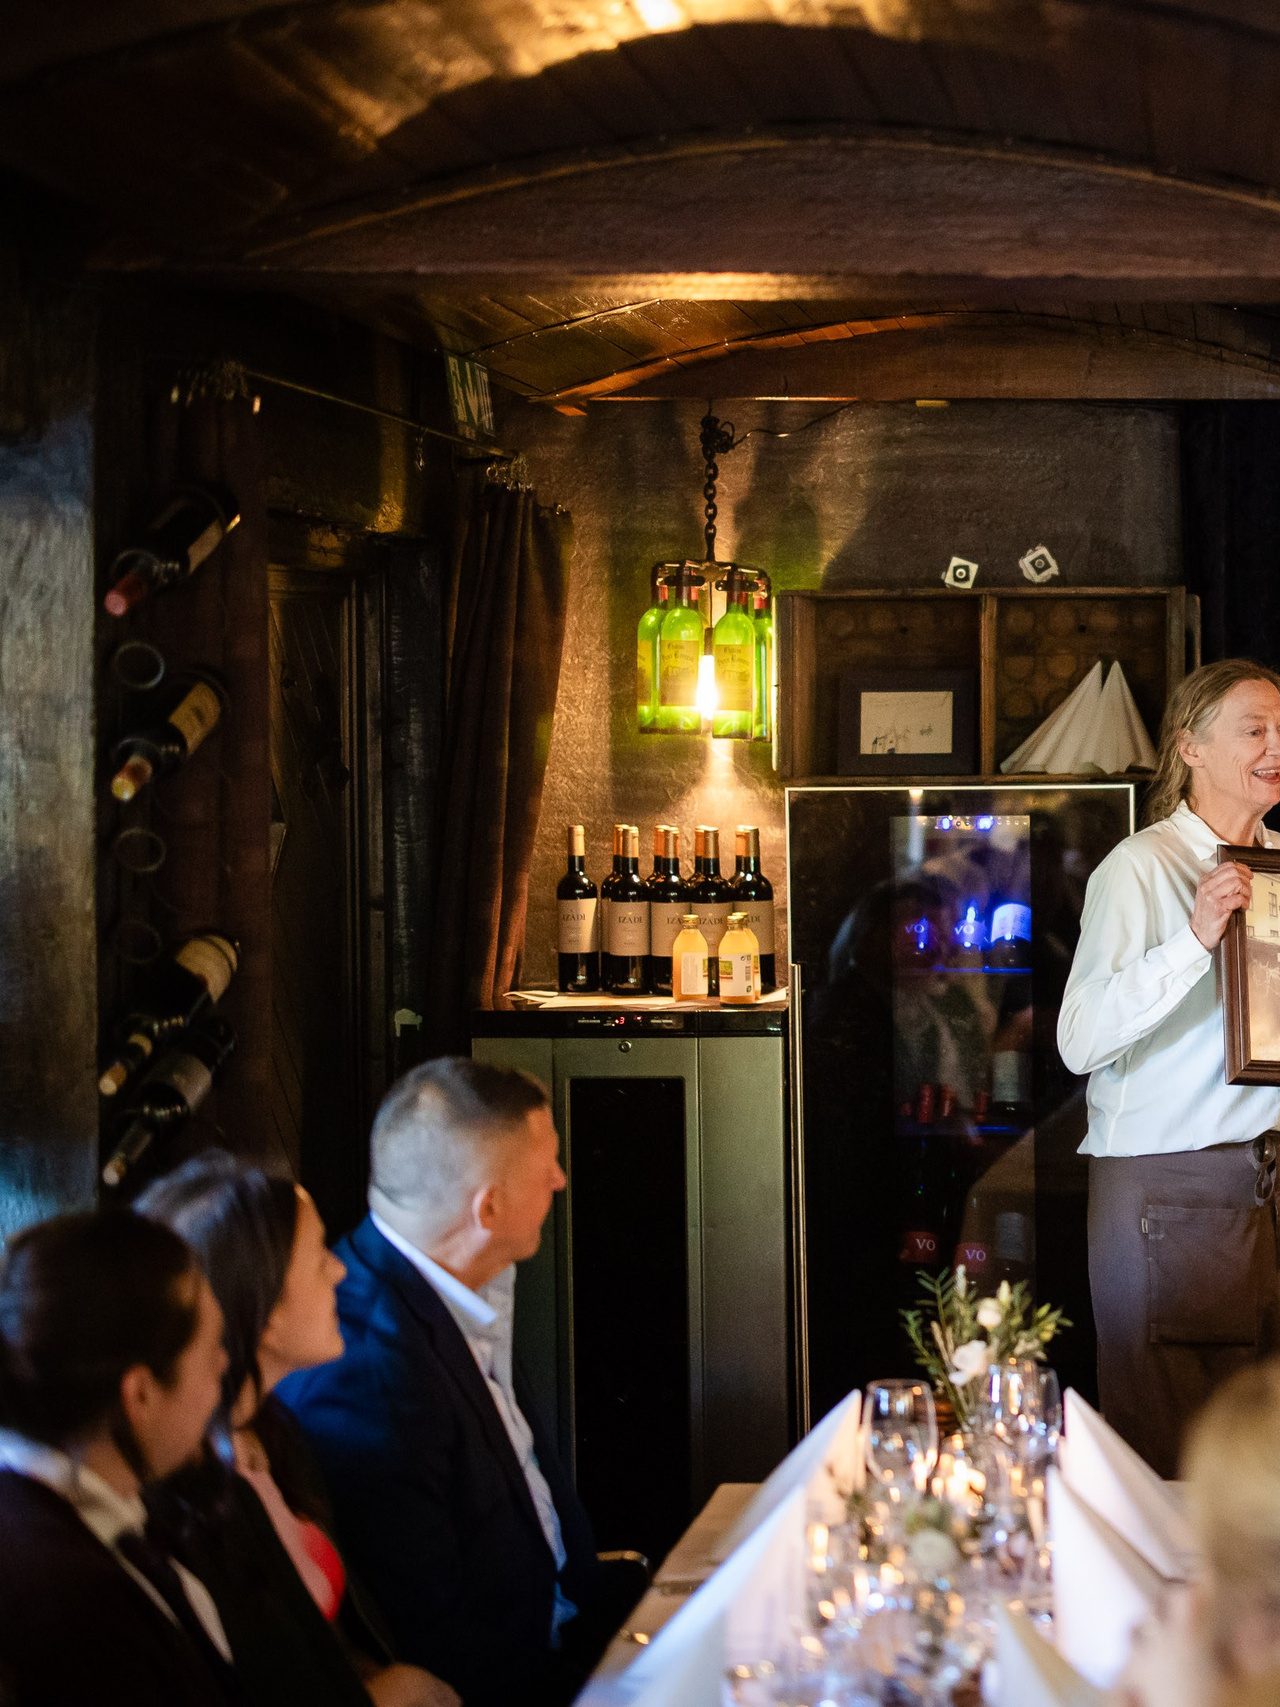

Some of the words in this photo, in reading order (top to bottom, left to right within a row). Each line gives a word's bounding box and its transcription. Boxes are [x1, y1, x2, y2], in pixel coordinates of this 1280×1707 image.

[562, 913, 586, 921] IZADI
[699, 917, 724, 925] IZADI
[905, 924, 925, 934] VO
[954, 923, 975, 935] VO
[916, 1238, 936, 1251] VO
[965, 1249, 986, 1261] VO
